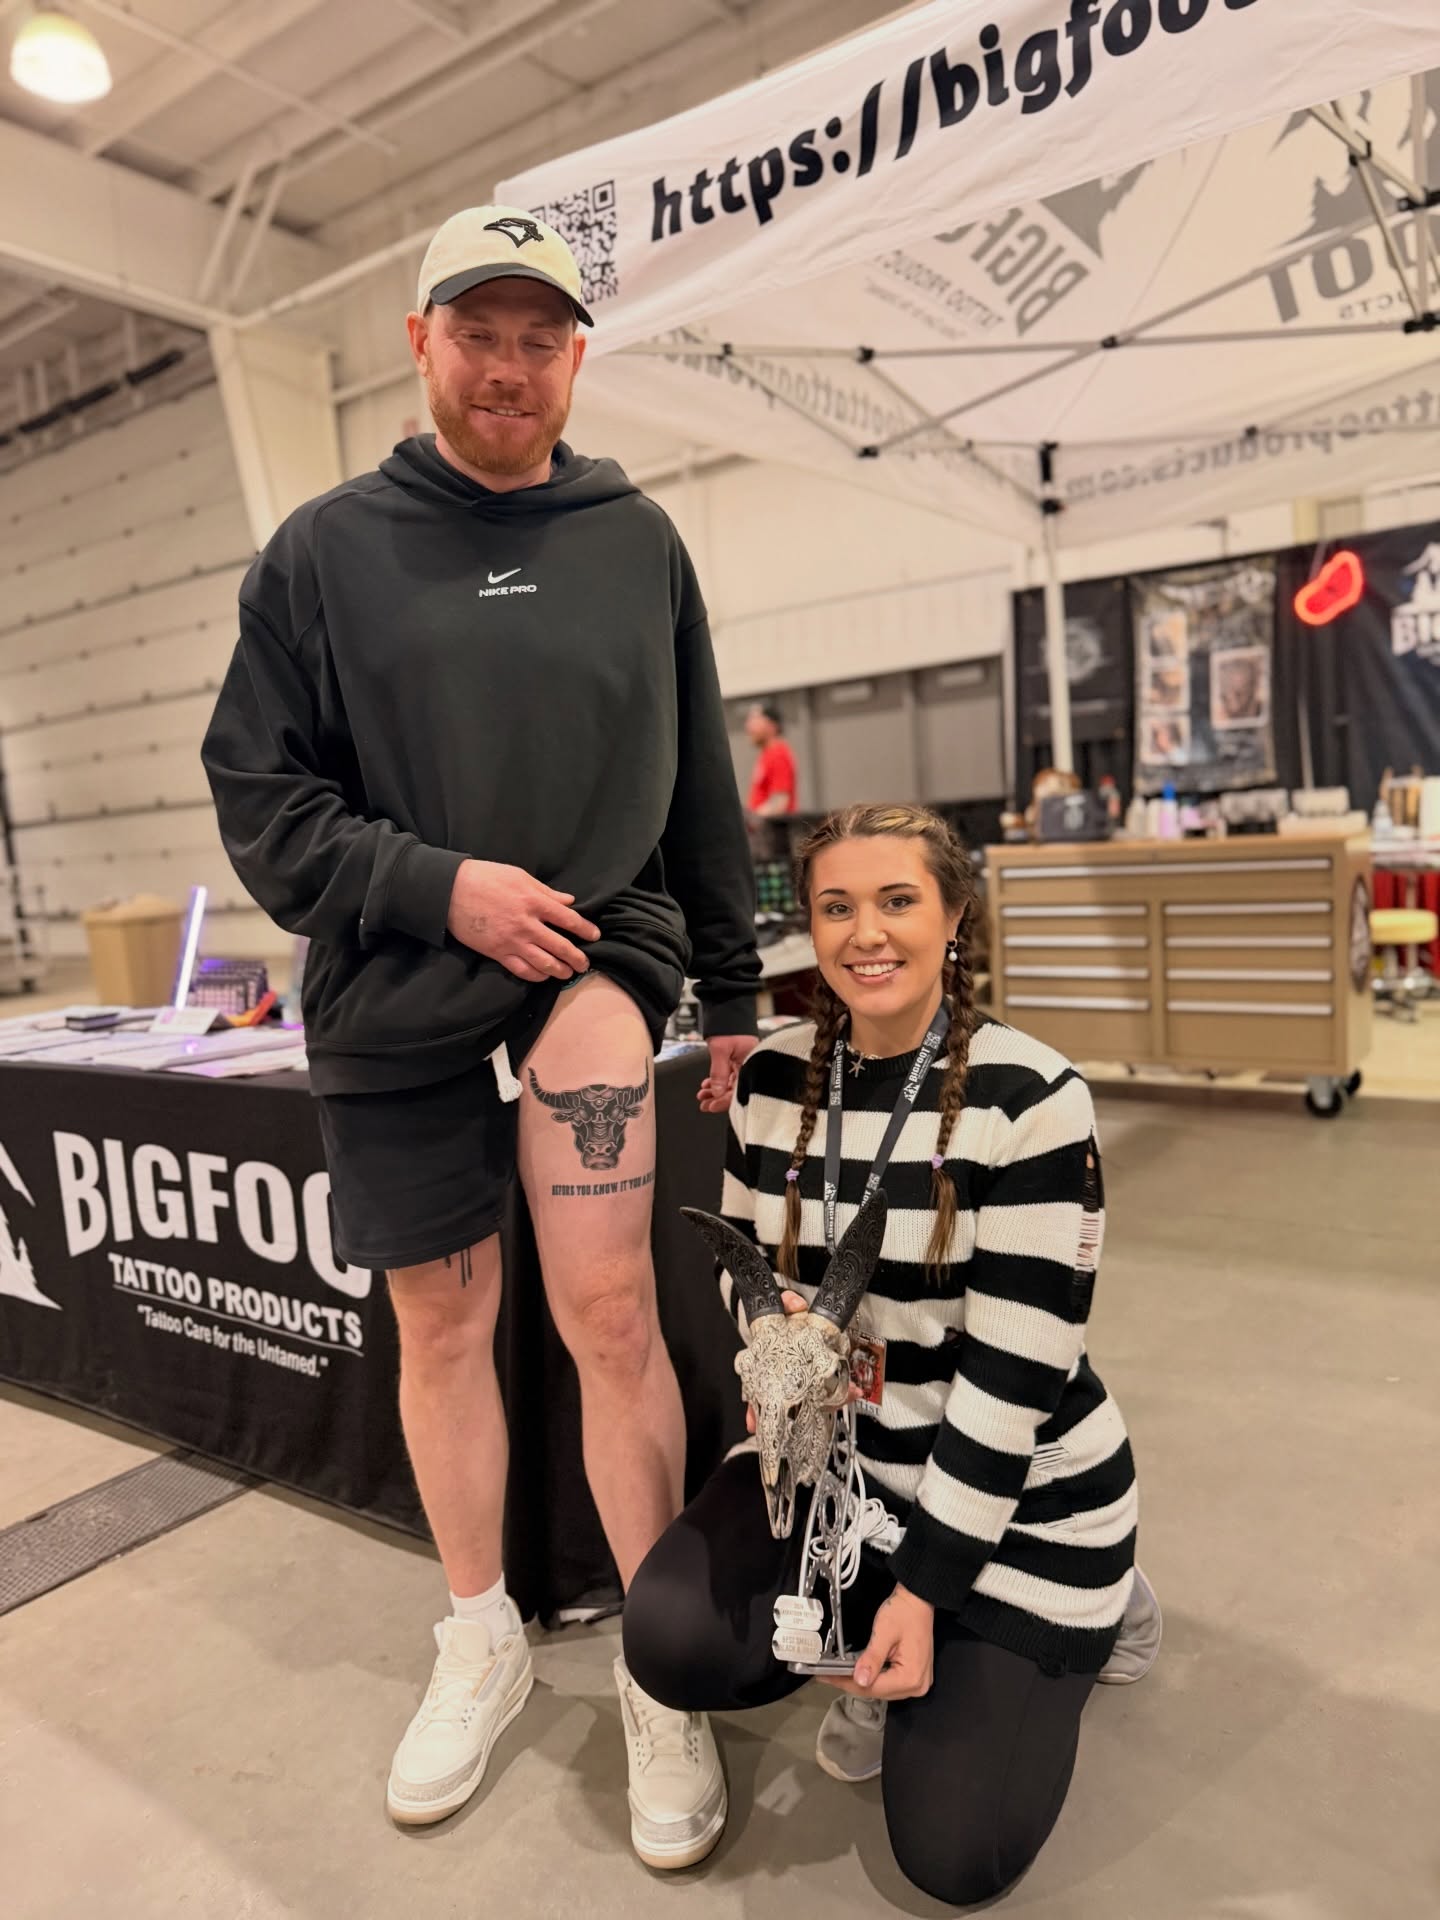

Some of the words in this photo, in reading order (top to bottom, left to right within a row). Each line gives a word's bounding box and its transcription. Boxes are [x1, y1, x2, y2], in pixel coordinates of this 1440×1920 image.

[479, 587, 509, 597] NIKE
[510, 585, 537, 594] PRO
[576, 1184, 591, 1196] YOU
[592, 1182, 618, 1196] KNOW
[619, 1179, 628, 1193] IT
[108, 1252, 203, 1304] TATTOO
[207, 1277, 364, 1348] PRODUCTS
[137, 1304, 183, 1335] "Tattoo
[183, 1316, 212, 1344] Care
[212, 1325, 232, 1350] for
[232, 1335, 256, 1356] the
[256, 1337, 329, 1378] Untamed."
